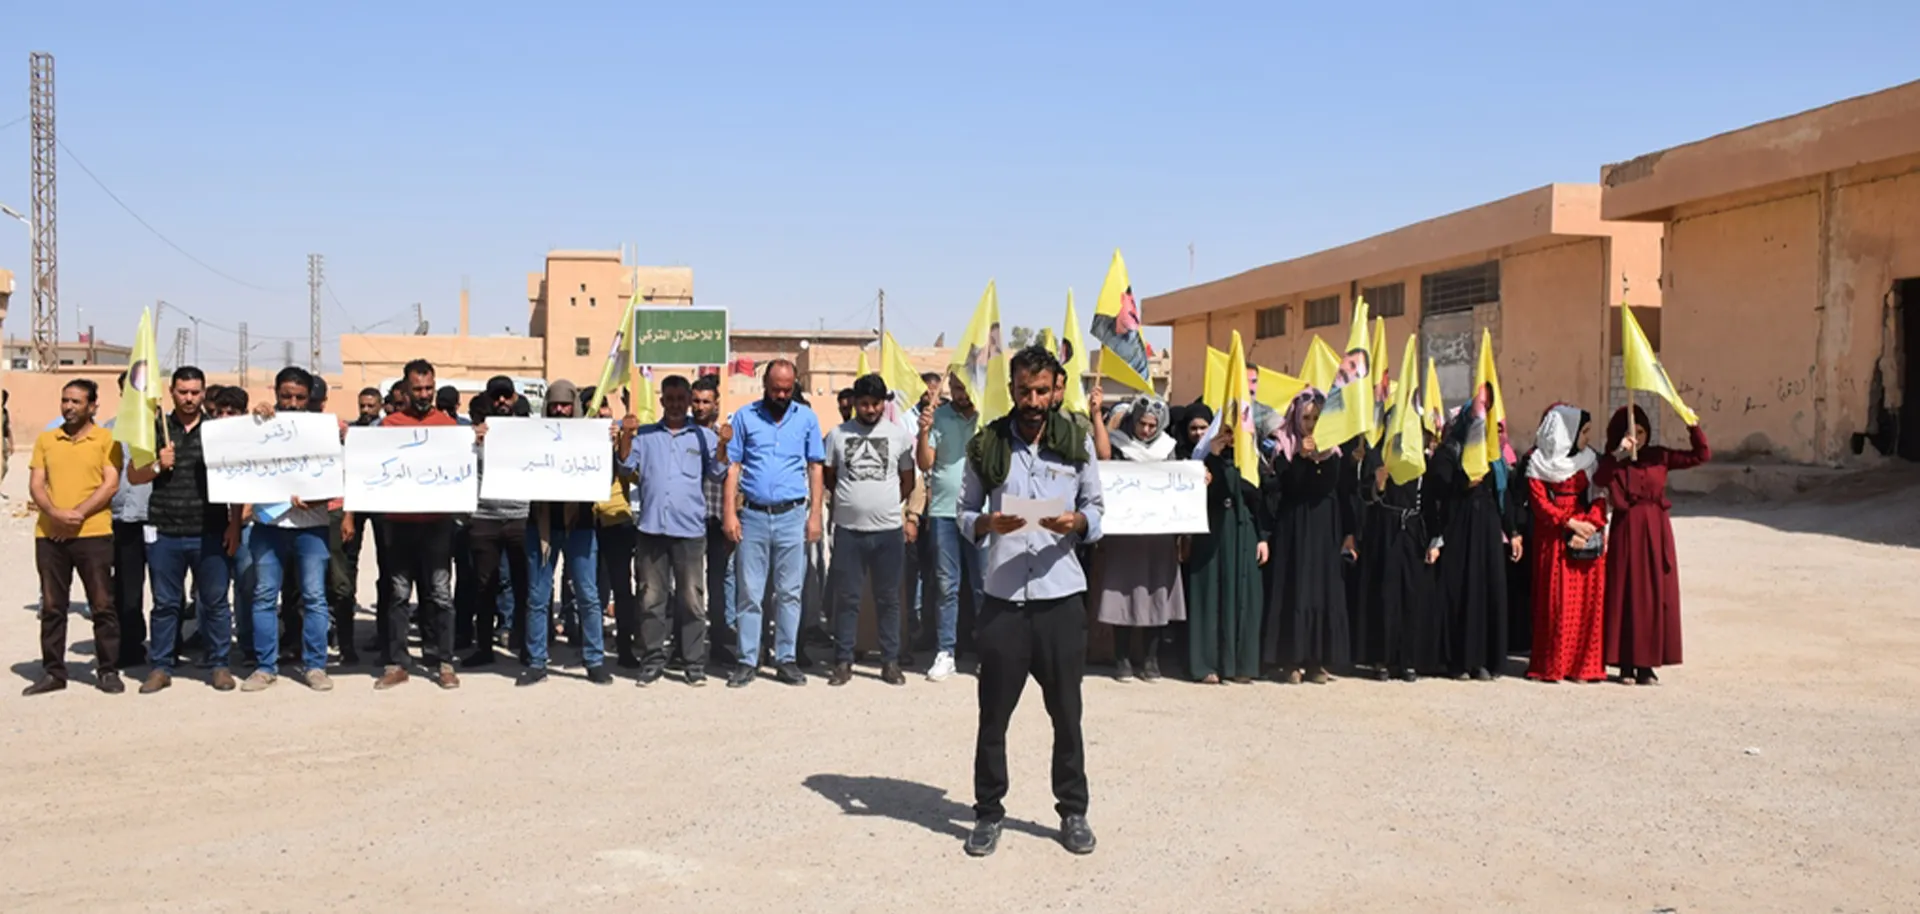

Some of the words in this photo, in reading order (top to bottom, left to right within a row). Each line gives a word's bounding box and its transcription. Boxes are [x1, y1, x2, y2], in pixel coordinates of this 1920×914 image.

[638, 328, 672, 346] التركي
[671, 328, 713, 343] للاحتلال
[714, 328, 723, 341] لا
[397, 428, 429, 450] لا
[544, 421, 563, 442] لا
[1147, 472, 1196, 495] نطالب
